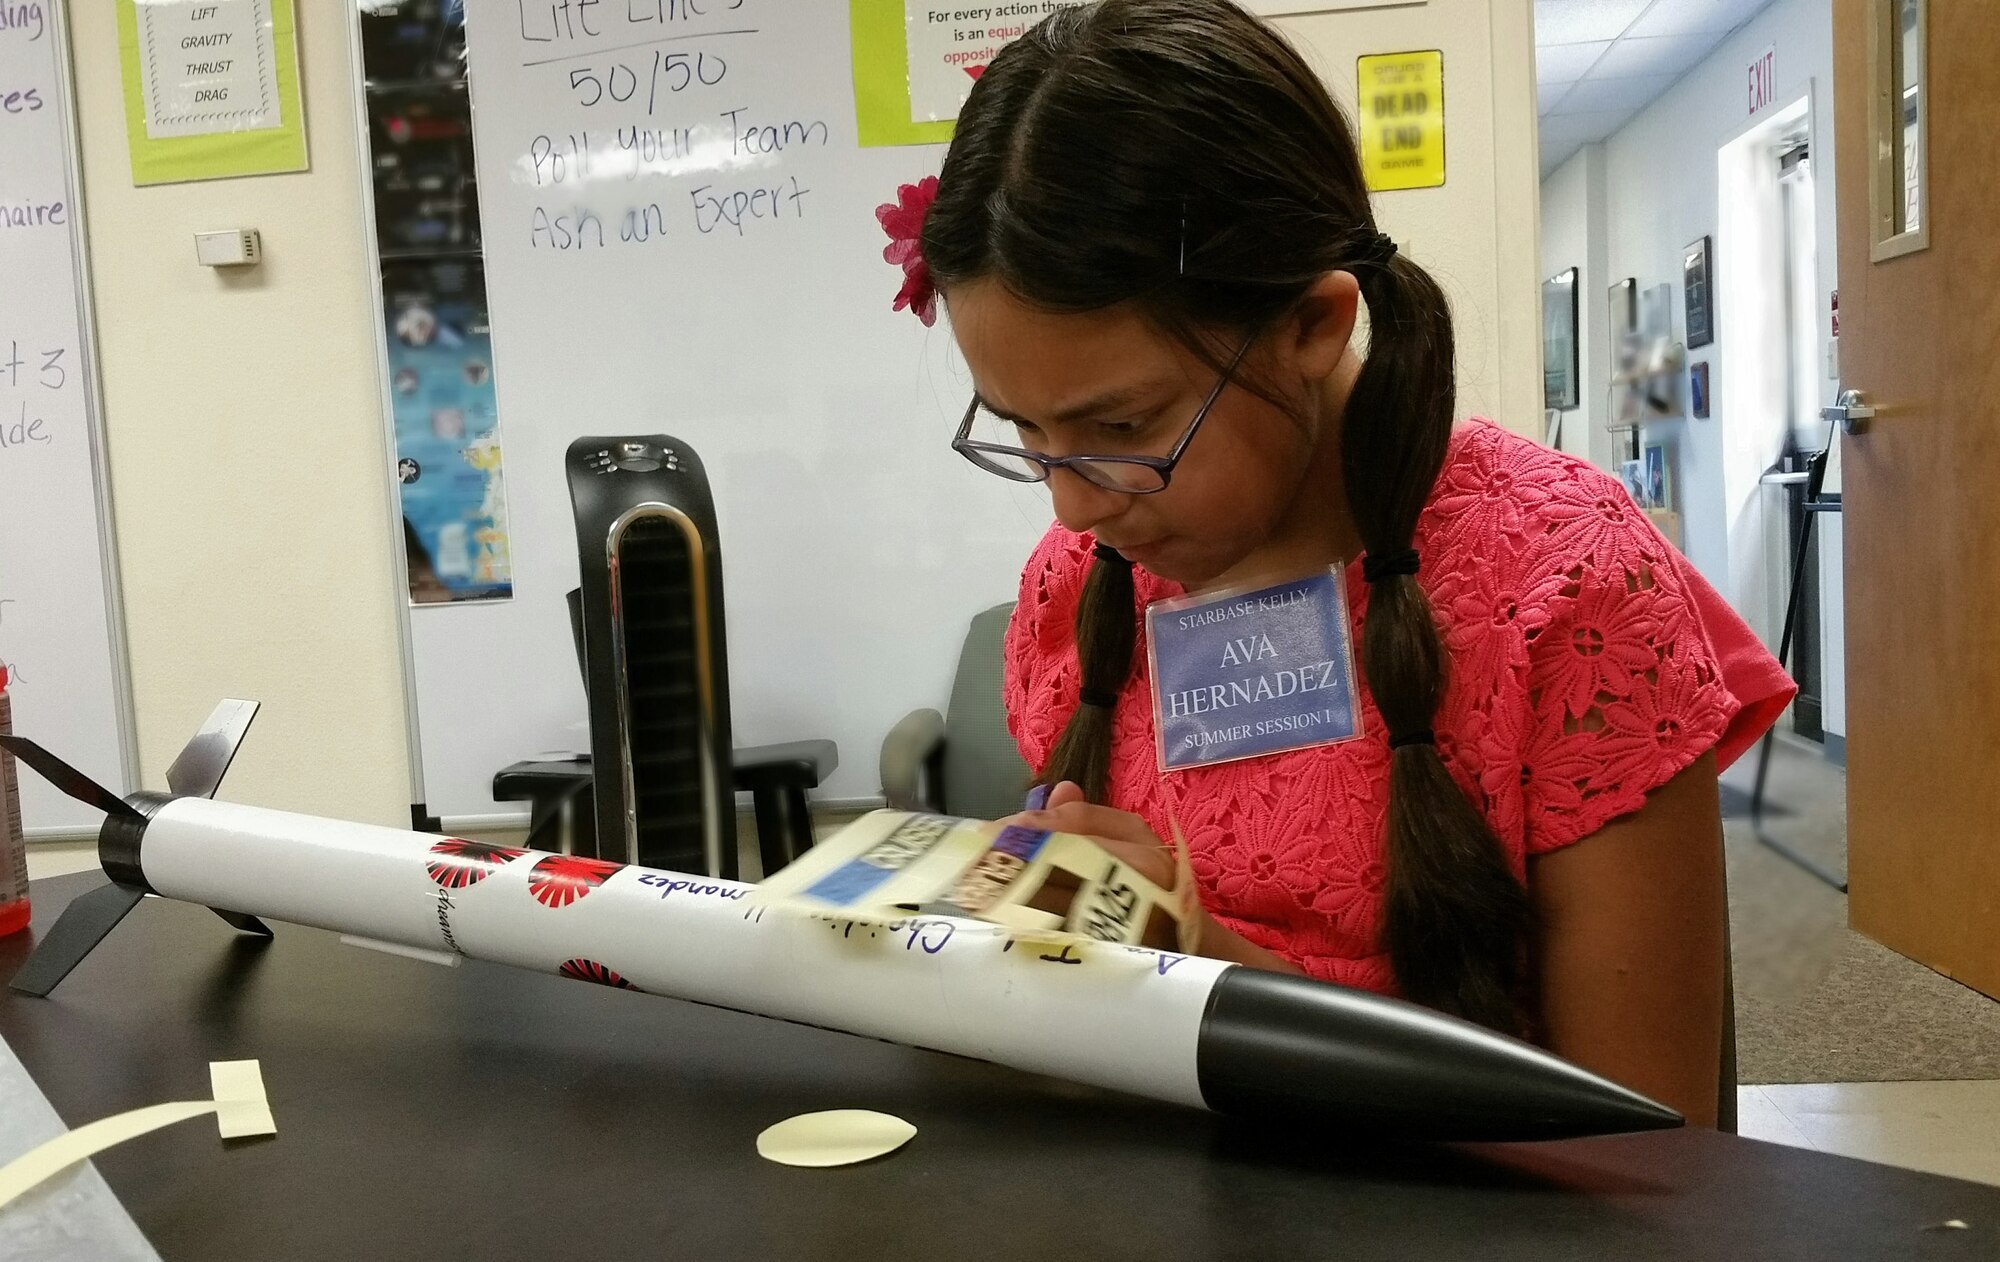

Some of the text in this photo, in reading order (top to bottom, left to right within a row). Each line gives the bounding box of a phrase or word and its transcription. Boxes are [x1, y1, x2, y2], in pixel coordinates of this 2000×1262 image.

[191, 6, 218, 21] LIFT
[628, 0, 743, 23] Lin
[928, 11, 950, 23] For
[954, 8, 992, 21] every
[995, 3, 1038, 17] action
[181, 33, 232, 49] GRAVITY
[954, 22, 1025, 41] is an equal
[186, 60, 234, 76] THRUST
[194, 88, 228, 103] DRAG
[569, 51, 726, 115] 50/50
[1749, 52, 1773, 115] EXIT
[0, 88, 43, 113] es
[1373, 92, 1428, 119] DEAD
[531, 131, 588, 185] Poll
[720, 107, 827, 156] Team
[1382, 126, 1422, 152] END
[1380, 158, 1425, 170] GAME
[620, 203, 667, 243] an
[691, 176, 810, 236] Expert
[1179, 588, 1309, 631] STARBASE KELLY
[1220, 633, 1279, 669] AVA
[1168, 660, 1338, 718] HERNADEZ
[1185, 724, 1252, 749] SUMMER
[1256, 712, 1320, 736] SESSION
